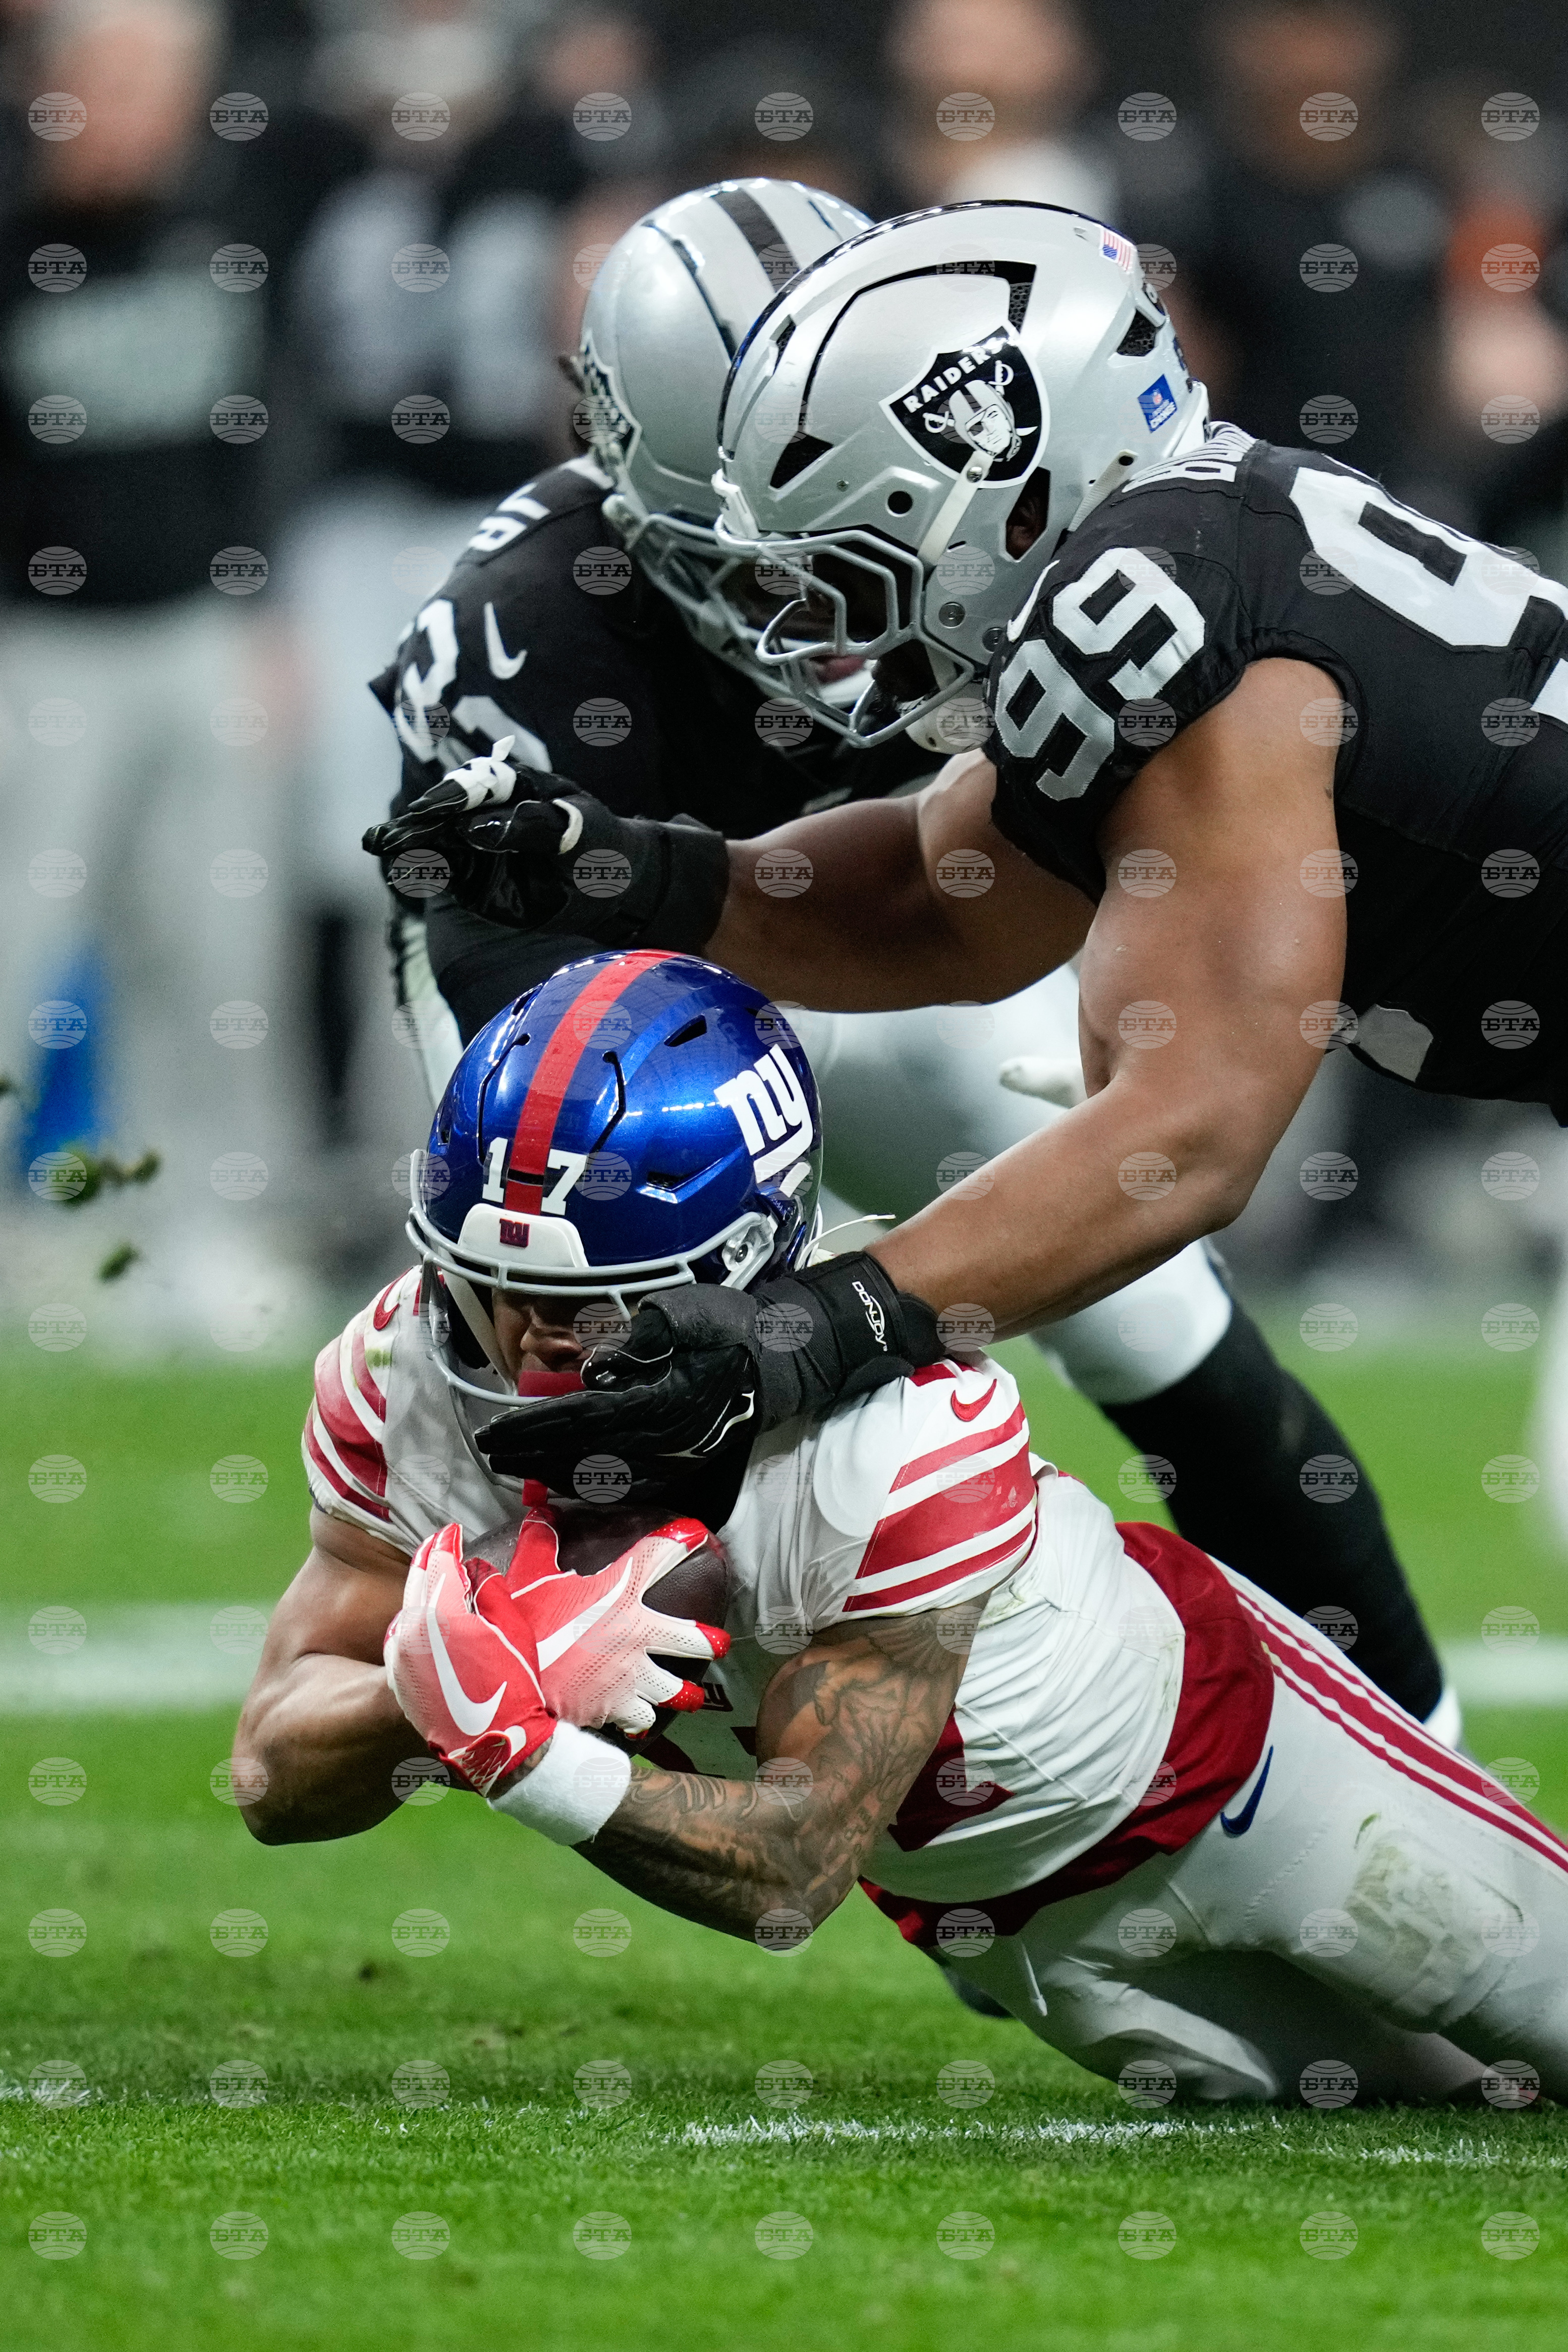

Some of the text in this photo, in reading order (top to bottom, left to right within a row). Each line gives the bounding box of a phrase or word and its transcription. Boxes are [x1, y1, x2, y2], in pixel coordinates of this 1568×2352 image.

[995, 547, 1206, 801] 99
[482, 1136, 587, 1216] 17
[852, 1280, 887, 1346] DONJOY
